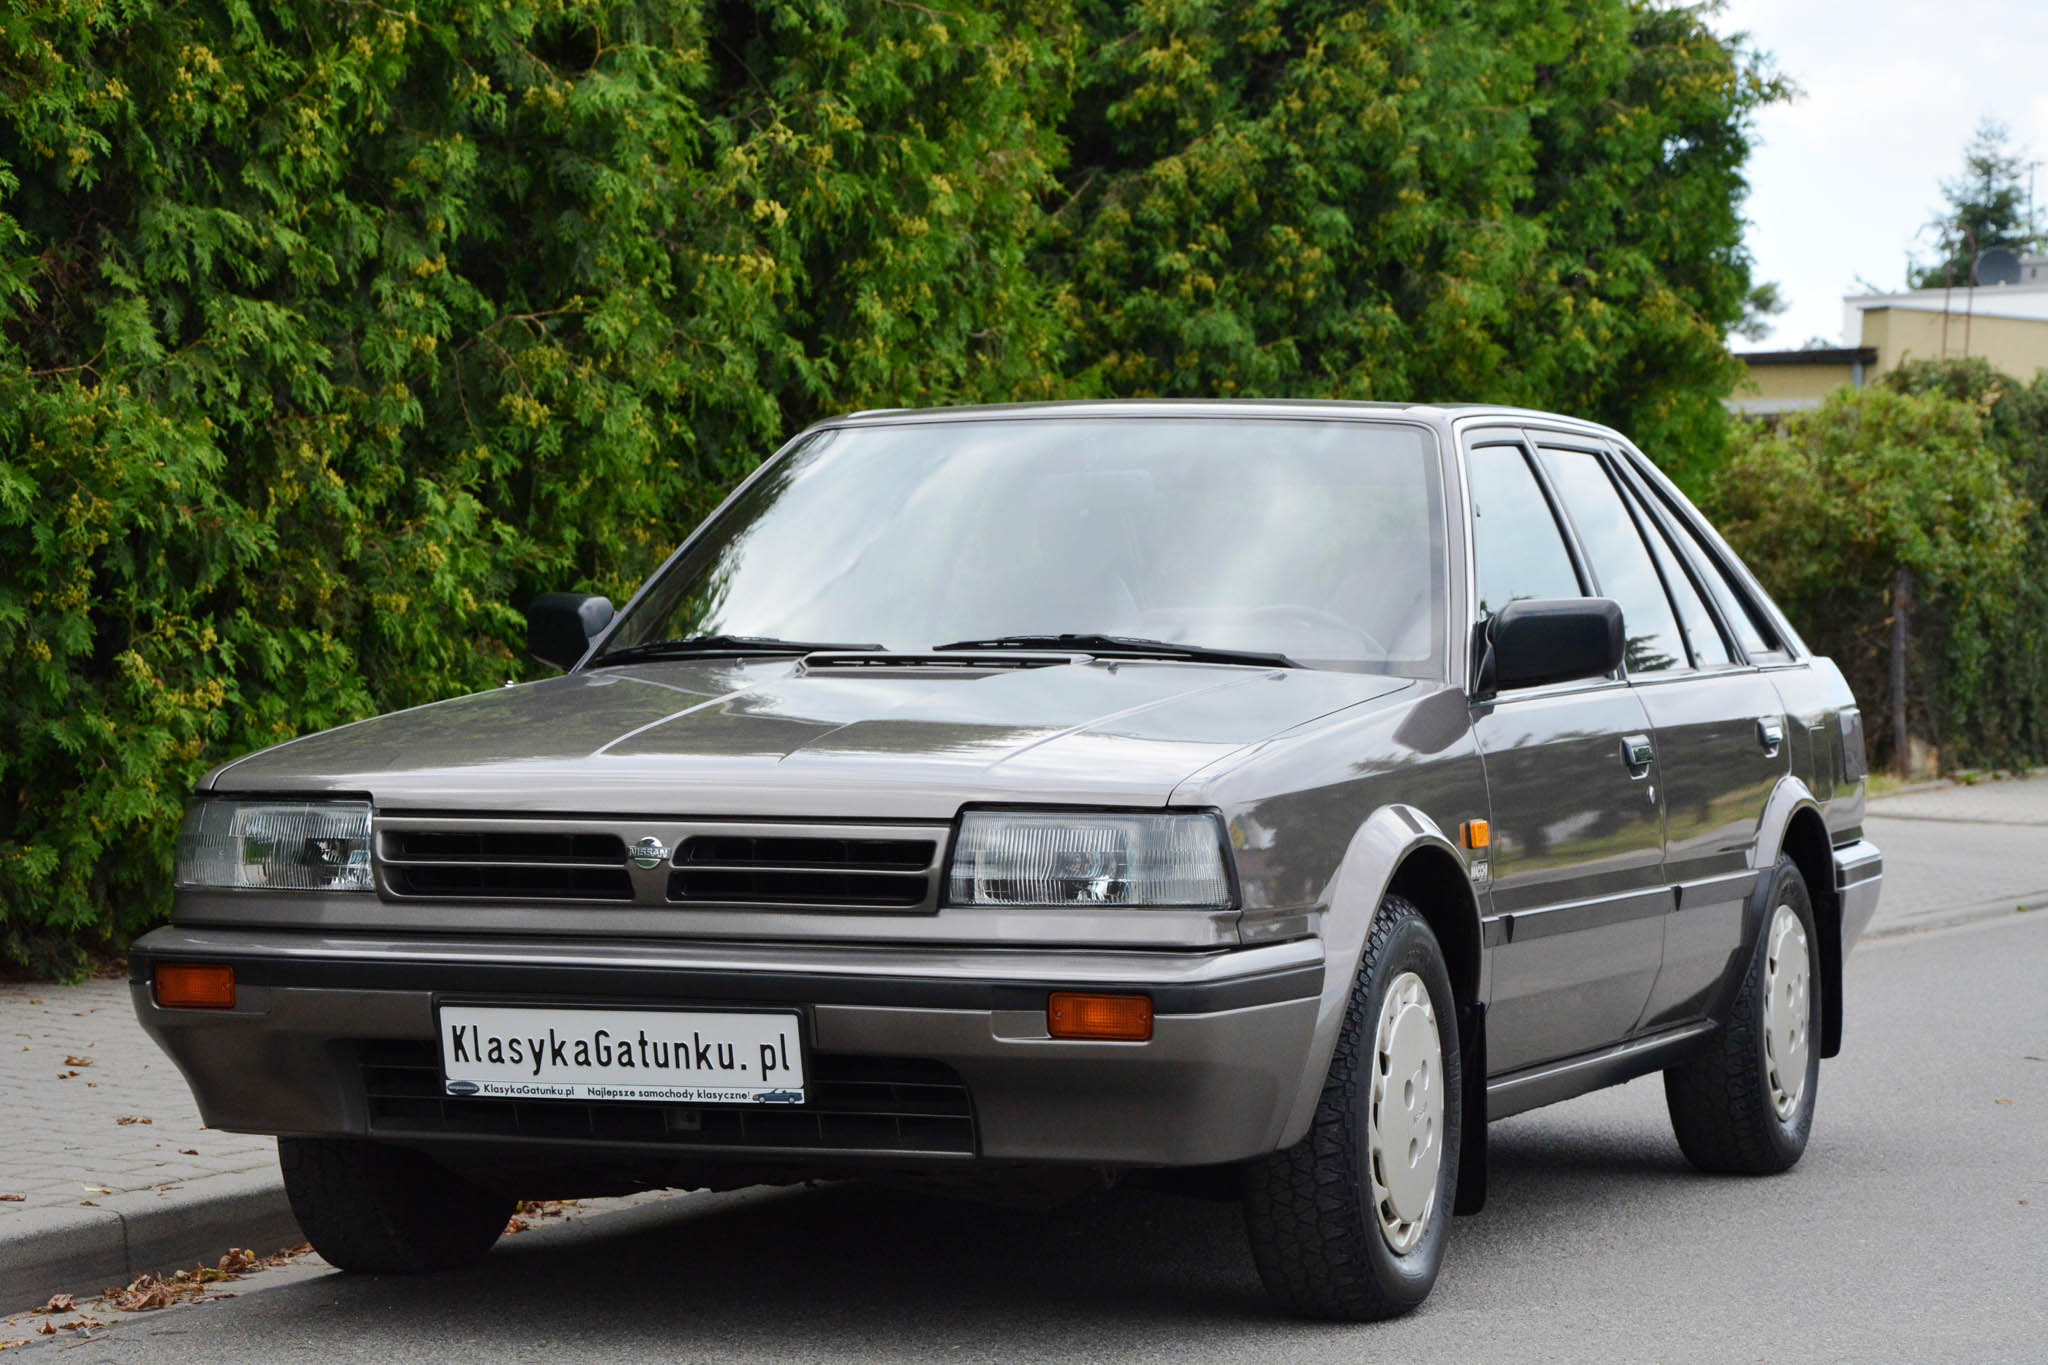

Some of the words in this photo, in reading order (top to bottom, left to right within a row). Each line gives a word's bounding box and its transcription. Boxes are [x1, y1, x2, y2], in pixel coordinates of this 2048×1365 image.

[629, 847, 668, 858] NISSAN
[483, 1083, 575, 1097] KlasykaGatunku.pl
[587, 1087, 636, 1099] Najlepsze
[638, 1088, 695, 1100] samochody
[696, 1089, 750, 1101] klasyczne!
